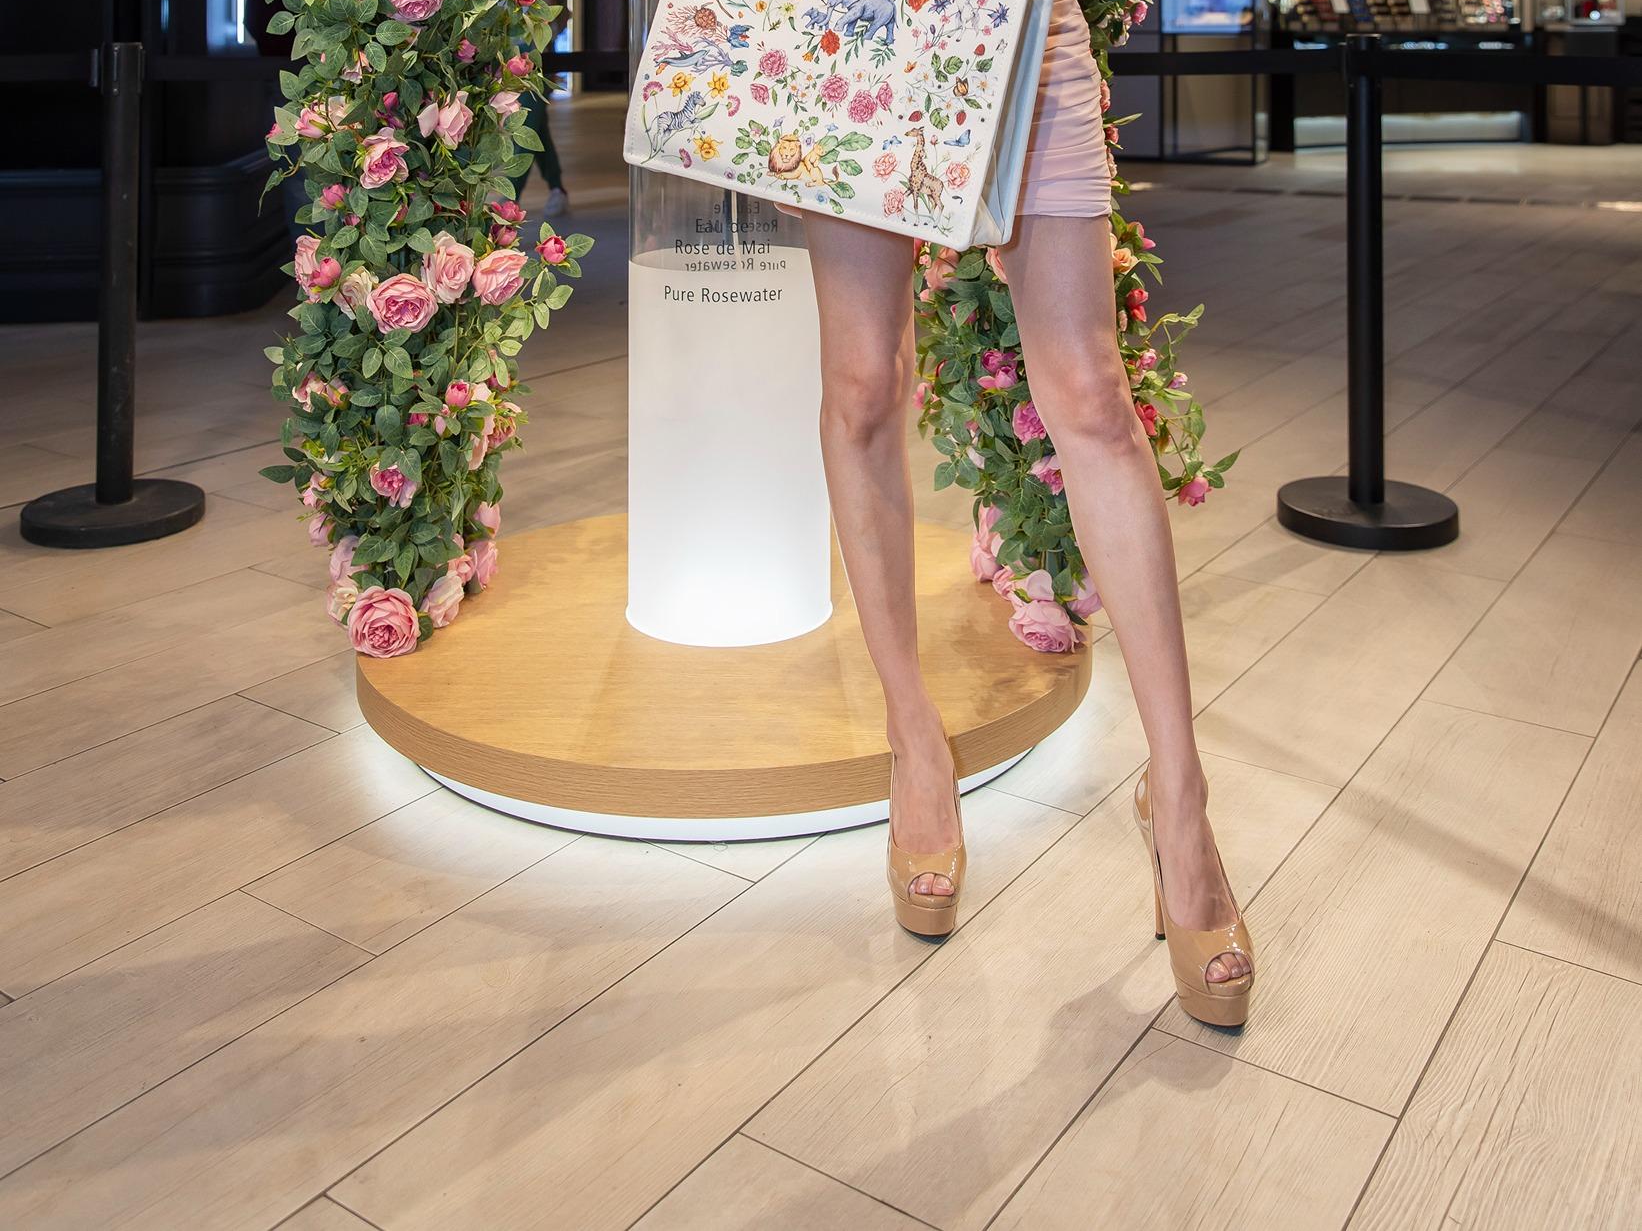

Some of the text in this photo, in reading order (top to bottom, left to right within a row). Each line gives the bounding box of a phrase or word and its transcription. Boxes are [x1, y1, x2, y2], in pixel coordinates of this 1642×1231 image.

[695, 218, 723, 234] Eau
[675, 238, 771, 255] Rose de Mai
[664, 285, 783, 303] Pure Rosewater
